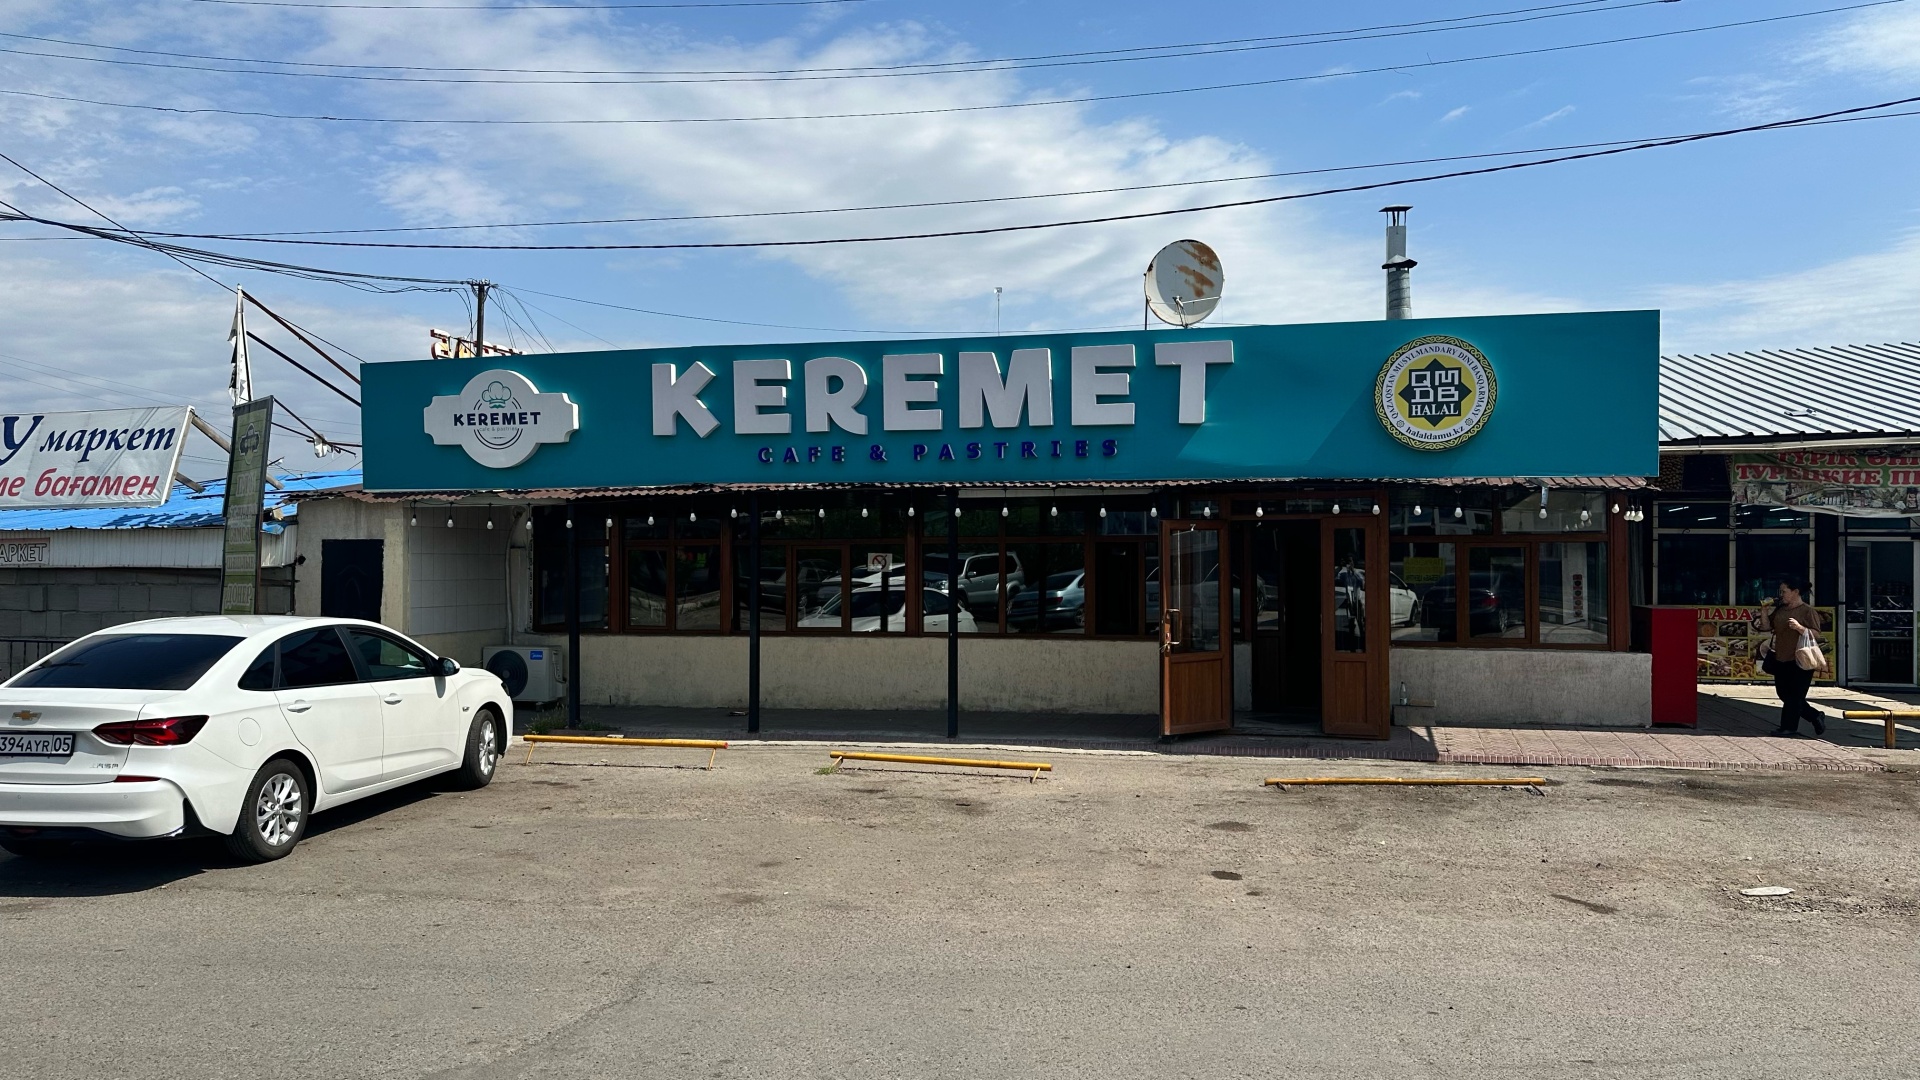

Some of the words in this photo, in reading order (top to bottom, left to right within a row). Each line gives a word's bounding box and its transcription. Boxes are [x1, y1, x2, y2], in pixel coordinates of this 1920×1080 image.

[651, 340, 1234, 438] KEREMET
[1385, 374, 1398, 419] QAZAQSTAN
[1393, 345, 1458, 373] MUSYLMANDARY
[1457, 351, 1474, 367] DINI
[1470, 364, 1486, 418] BASQARMASY
[453, 411, 541, 426] KEREMET
[1411, 403, 1459, 416] HALAL
[39, 427, 176, 463] маркет
[1405, 425, 1465, 440] halaldamu.kz
[758, 445, 846, 464] CAFE
[869, 443, 888, 462] &
[913, 439, 1119, 462] PASTRIES
[34, 468, 159, 497] бағамен
[1736, 464, 1881, 486] ТУРЕЦКИЕ
[226, 583, 252, 608] ДОНЕР
[0, 737, 50, 752] 394AYR
[53, 737, 71, 752] 05
